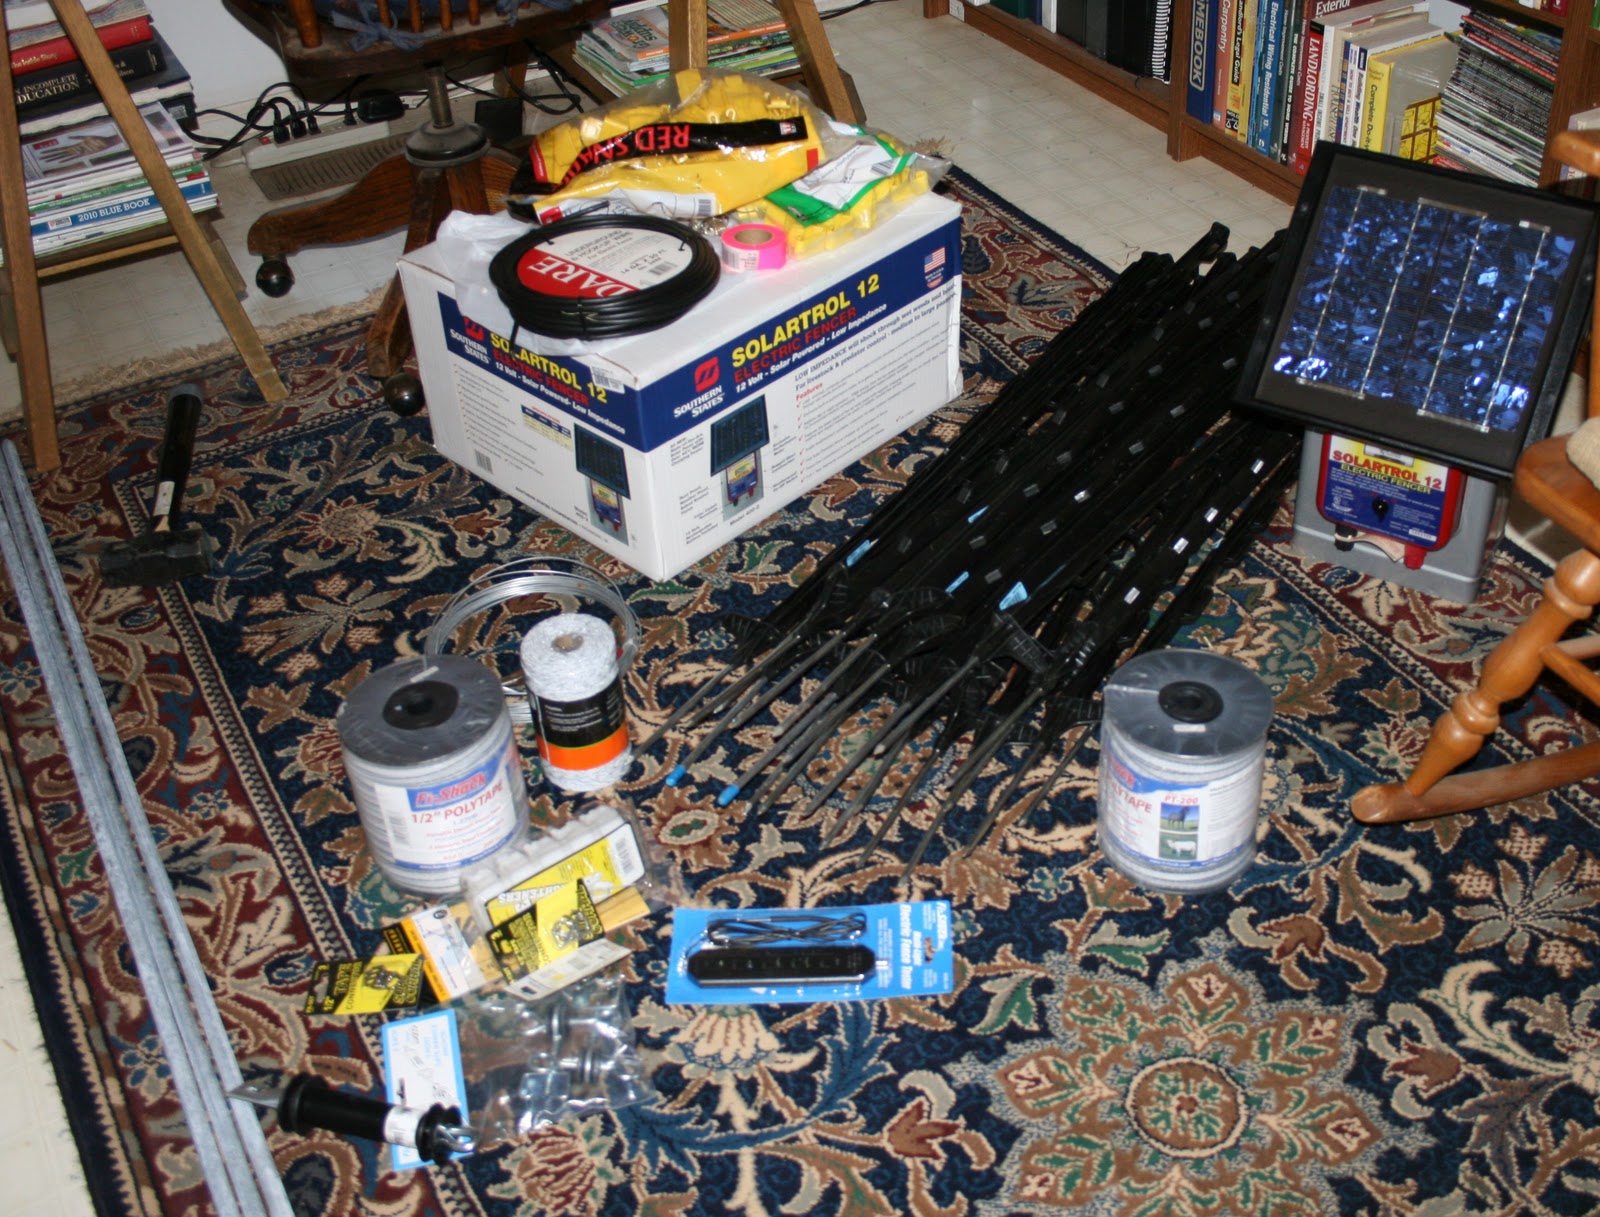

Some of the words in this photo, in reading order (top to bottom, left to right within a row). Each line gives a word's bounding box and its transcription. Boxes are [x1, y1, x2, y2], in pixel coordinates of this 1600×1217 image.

[1268, 2, 1279, 43] Electrical
[1316, 0, 1351, 15] Exterior
[1218, 0, 1231, 53] Carpentry
[1265, 44, 1276, 71] Wiring
[24, 73, 78, 93] INCOMPLETE
[1262, 71, 1273, 116] Residential
[1303, 37, 1320, 121] LANDLORDING
[1287, 95, 1292, 103] TO
[1367, 84, 1377, 122] Complete
[636, 124, 690, 152] RED
[78, 210, 98, 222] 2010
[100, 204, 123, 217] BLUE
[124, 197, 151, 211] BOOK
[564, 229, 623, 256] UNDERGROUND
[528, 256, 635, 297] DARE
[731, 290, 851, 368] SOLARTROL
[857, 273, 880, 299] 12
[450, 328, 488, 355] SOUTHERN
[464, 343, 490, 365] STATES
[733, 337, 802, 383] ELECTRIC
[805, 306, 857, 345] FENCER
[735, 380, 746, 394] 12
[747, 370, 764, 387] Volt
[770, 356, 790, 376] Solar
[792, 336, 826, 362] Powered
[831, 325, 847, 340] Low
[848, 303, 888, 330] Impedance
[794, 369, 810, 382] LOW
[810, 346, 848, 374] IMPEDANCE
[848, 339, 860, 351] will
[860, 329, 878, 344] shock
[877, 314, 901, 333] through
[913, 297, 931, 312] weeds
[795, 379, 807, 392] For
[807, 364, 834, 388] livestock
[840, 345, 866, 366] predator
[866, 332, 887, 350] control
[891, 319, 913, 335] medium
[921, 304, 936, 318] large
[493, 349, 545, 384] ELECTRIC
[545, 373, 590, 406] FENCER
[587, 382, 608, 403] 12
[796, 382, 824, 401] Features
[495, 361, 504, 371] 12
[505, 364, 517, 379] Volt
[522, 374, 540, 391] Solar
[572, 400, 587, 415] Low
[587, 407, 627, 435] Impedance
[674, 385, 723, 418] SOUTHERN
[691, 393, 725, 418] STATES
[1333, 450, 1420, 484] SOLARTROL
[1425, 475, 1443, 490] 12
[1341, 463, 1389, 483] ELECTRIC
[1390, 476, 1432, 496] FENCER
[415, 771, 487, 808] Fi-Shock
[444, 779, 505, 820] POLYTAPE
[1164, 794, 1199, 805] PT-200
[333, 962, 353, 996] TAPE
